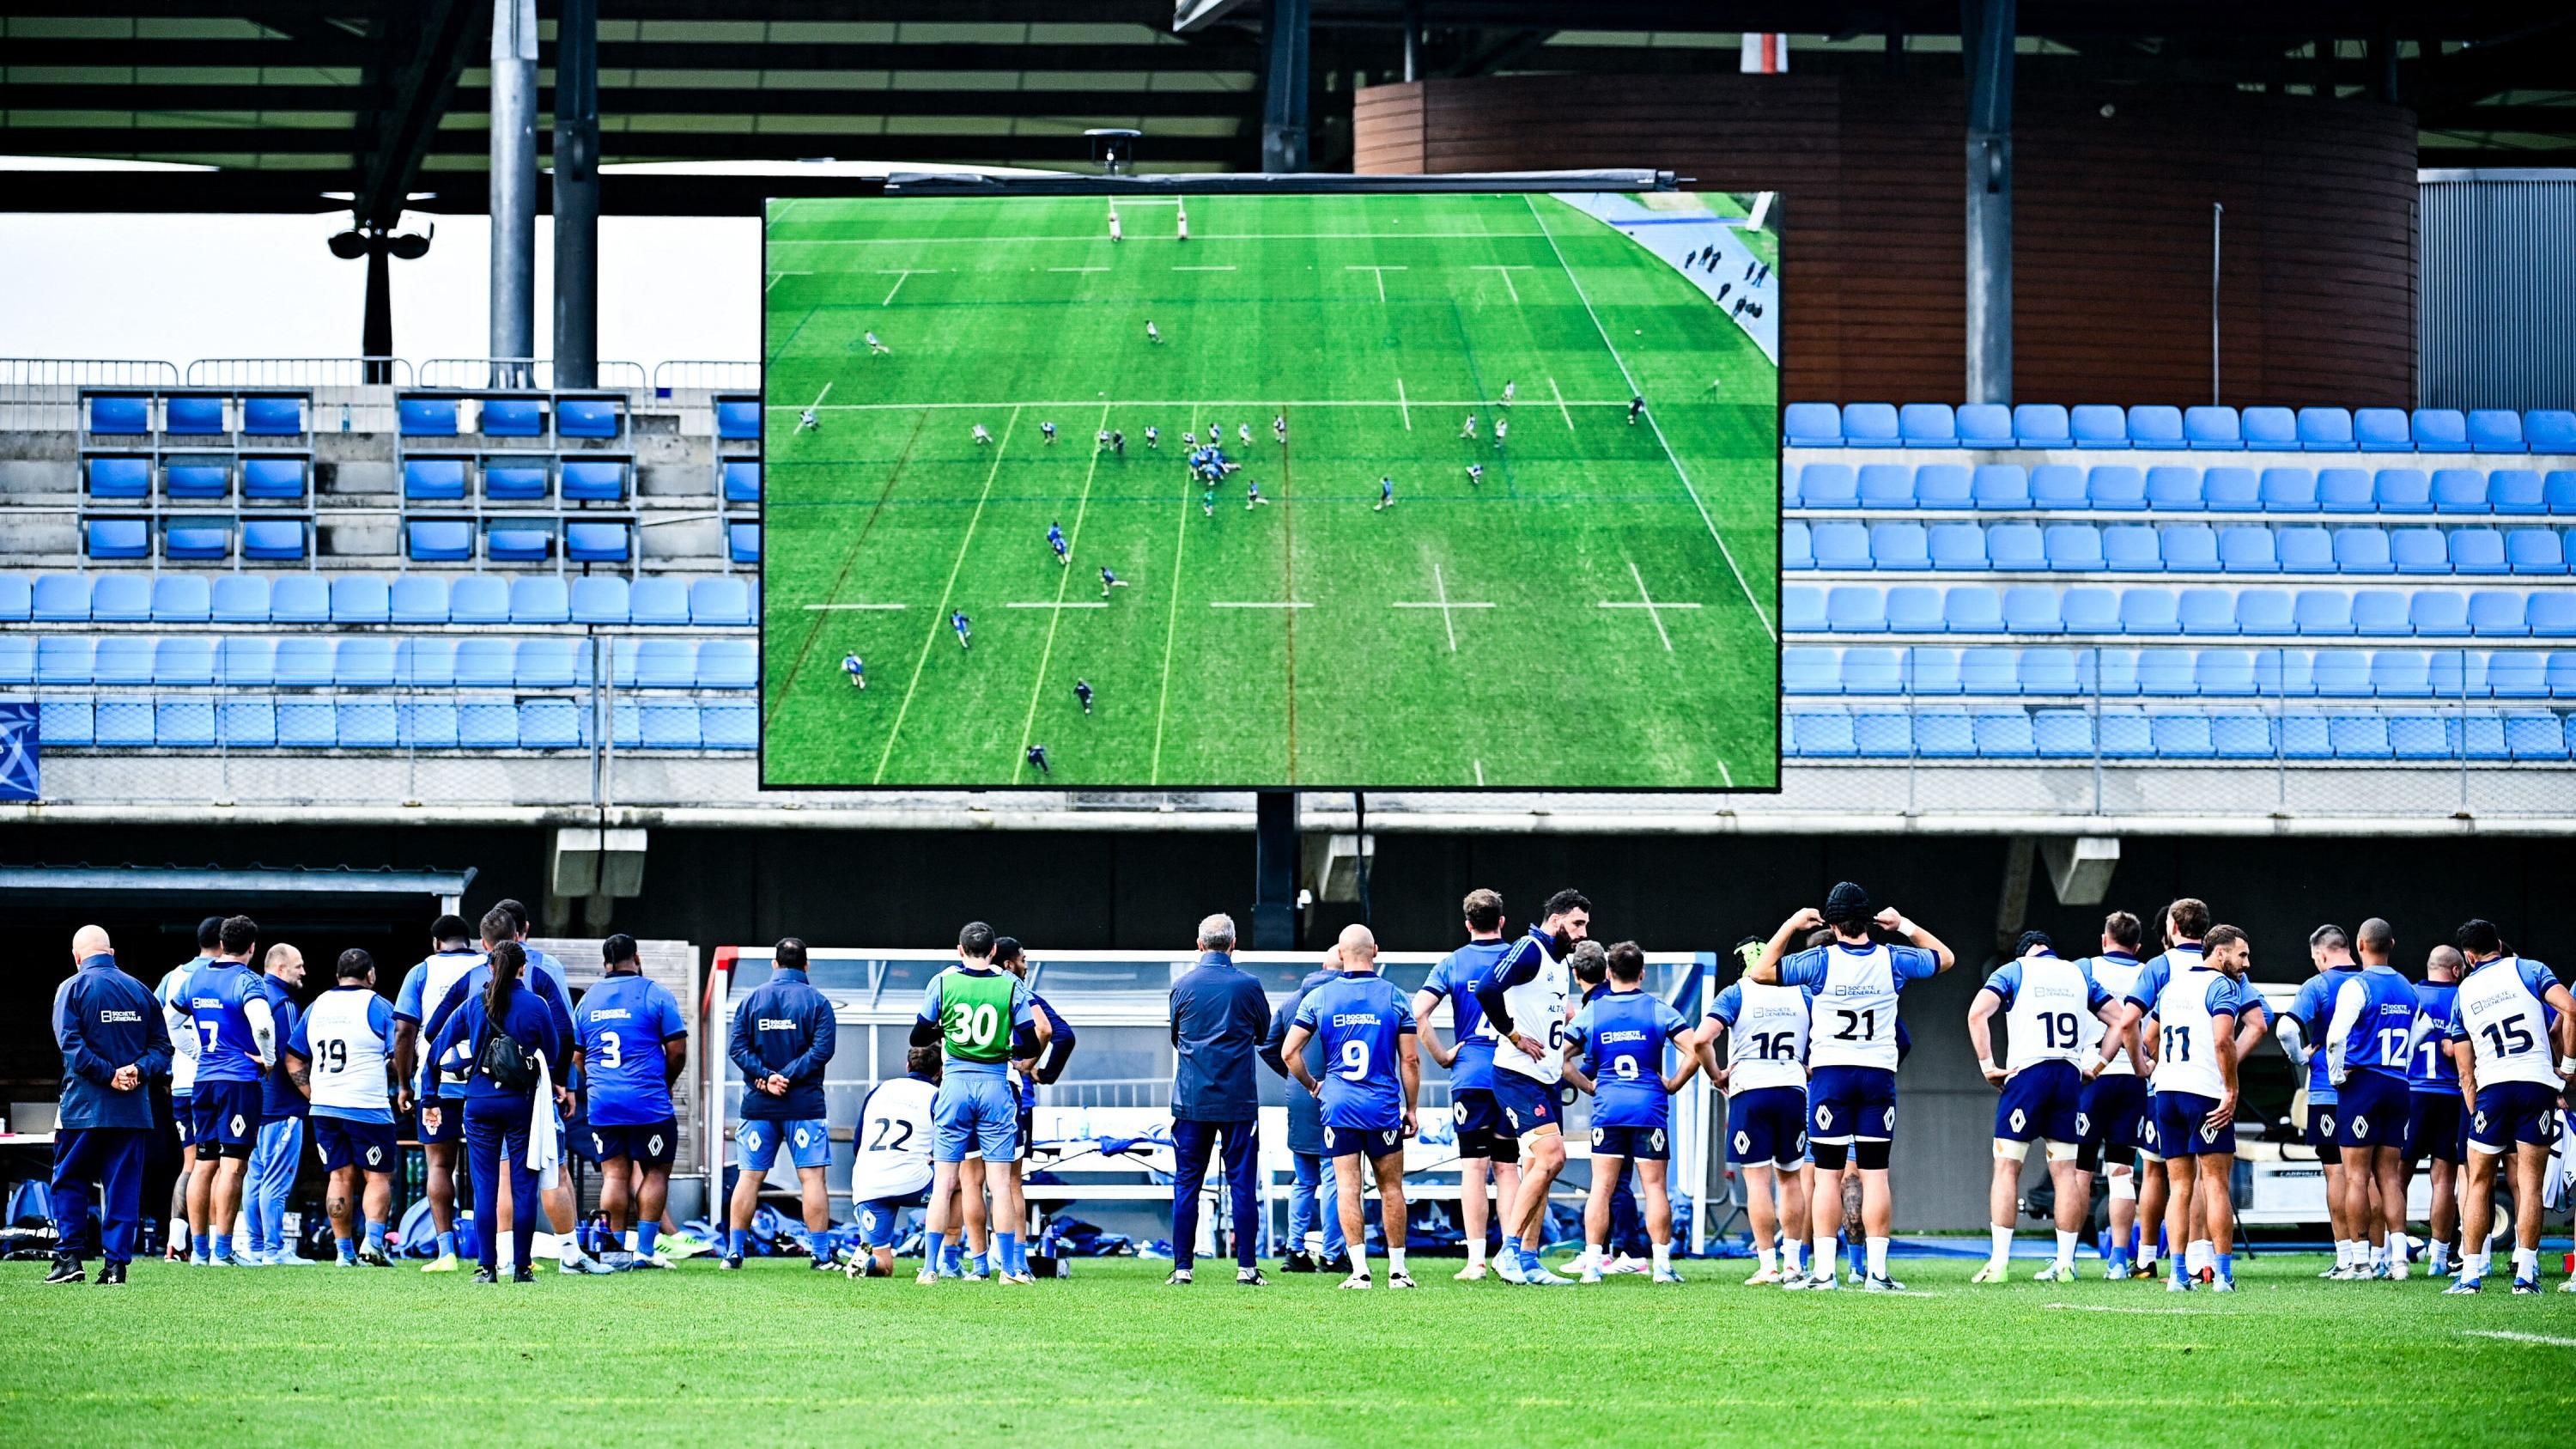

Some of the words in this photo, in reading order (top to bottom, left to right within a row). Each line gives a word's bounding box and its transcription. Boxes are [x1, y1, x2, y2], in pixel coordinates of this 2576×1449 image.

[199, 1020, 219, 1052] 7
[951, 1003, 998, 1045] 30
[1475, 1011, 1499, 1040] 4
[1549, 1020, 1563, 1050] 6
[1834, 1009, 1874, 1040] 21
[2037, 1012, 2078, 1049] 19
[2482, 1013, 2534, 1058] 15
[317, 1039, 346, 1073] 19
[600, 1032, 621, 1068] 3
[1341, 1039, 1369, 1081] 9
[1752, 1032, 1795, 1060] 16
[2164, 1025, 2190, 1062] 11
[2377, 1028, 2409, 1067] 12
[2419, 1042, 2436, 1079] 1
[1614, 1055, 1639, 1081] 9
[869, 1118, 913, 1152] 22
